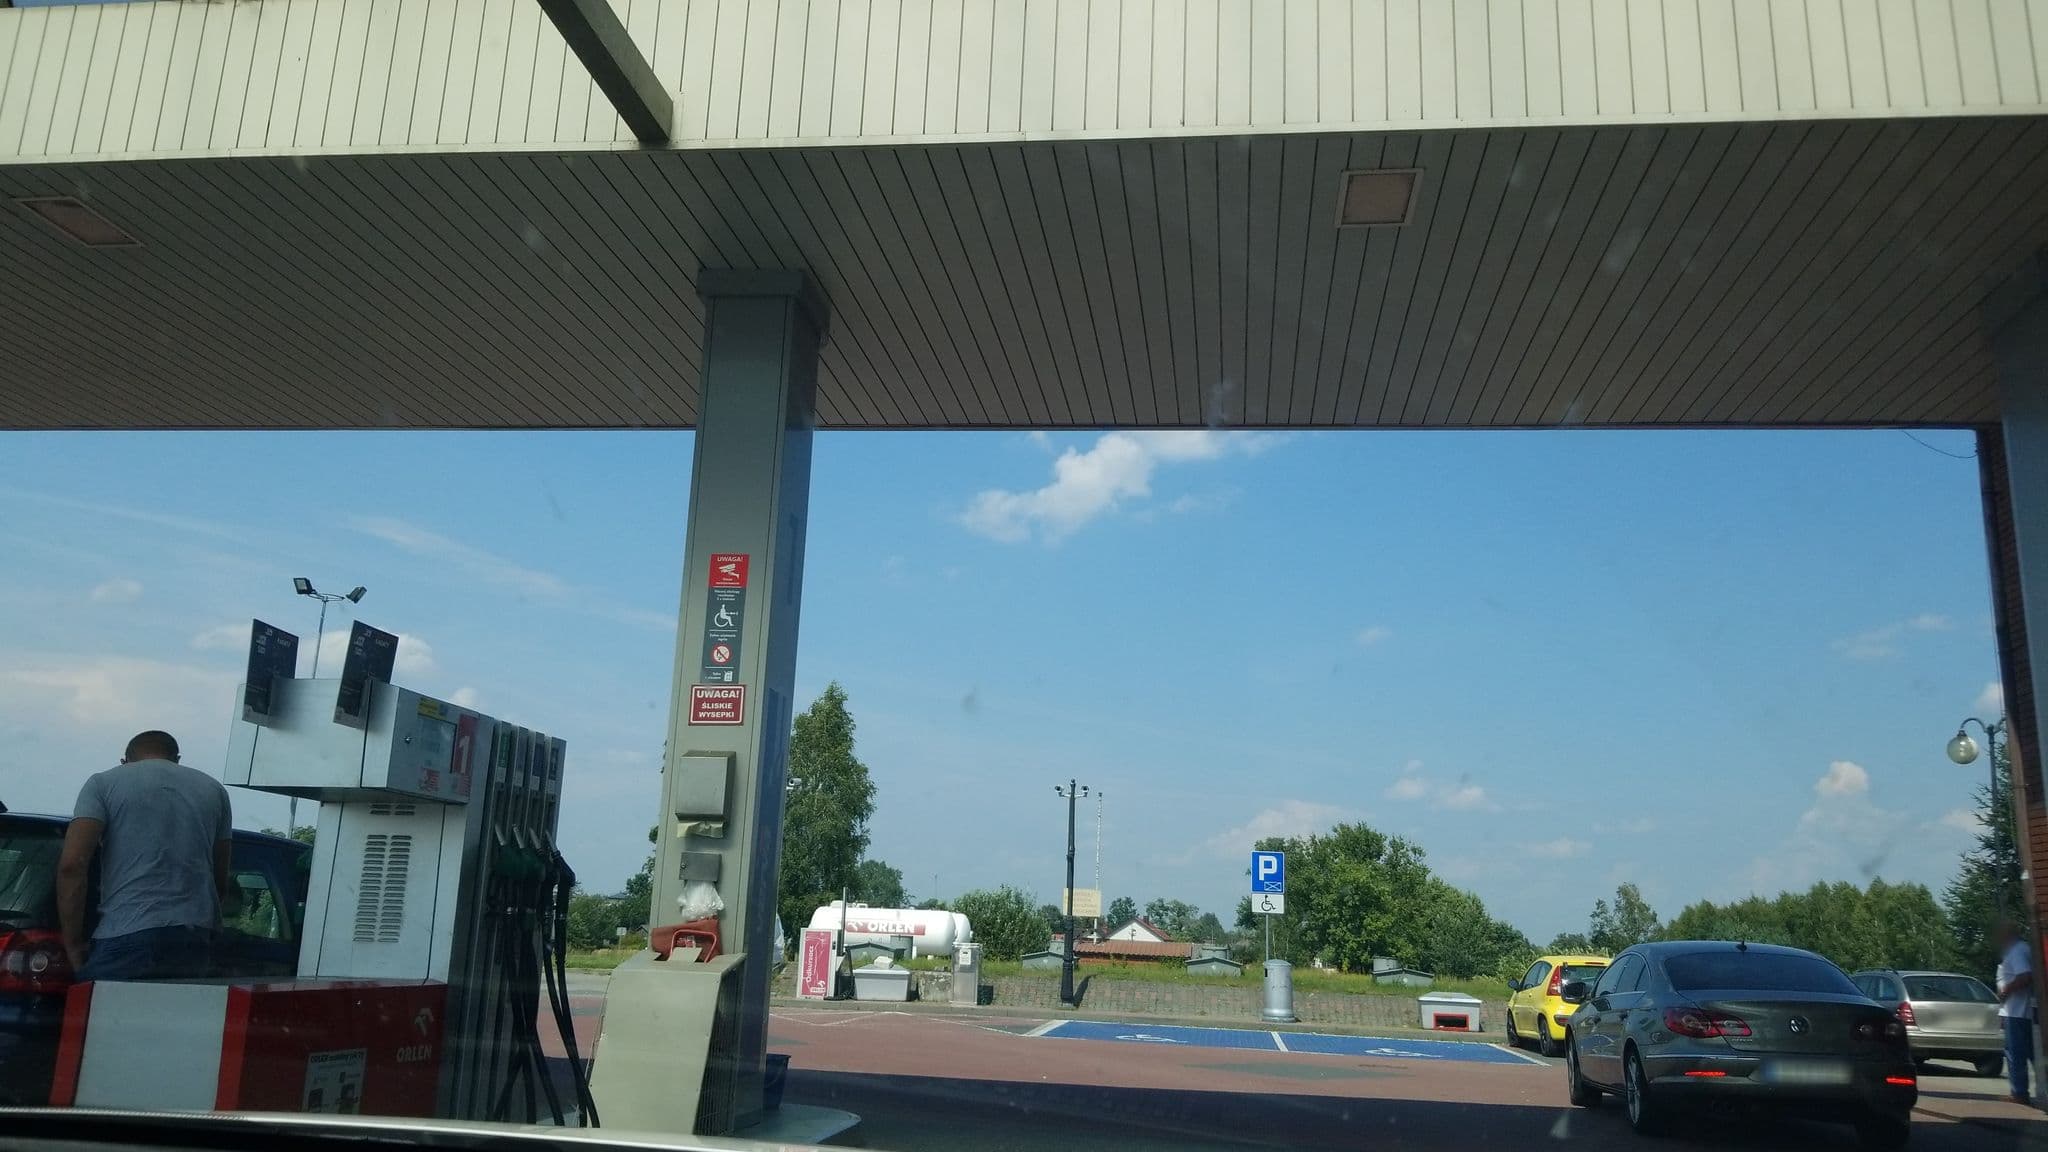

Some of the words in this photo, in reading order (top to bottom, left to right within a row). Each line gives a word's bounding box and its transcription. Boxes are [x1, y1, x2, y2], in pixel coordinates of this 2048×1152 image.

[697, 690, 739, 698] UWAGA!
[702, 701, 733, 709] ŚLISKIE
[459, 736, 470, 774] 1
[1259, 855, 1277, 880] P
[868, 921, 914, 934] ORLEN
[396, 1045, 432, 1062] ORLEN
